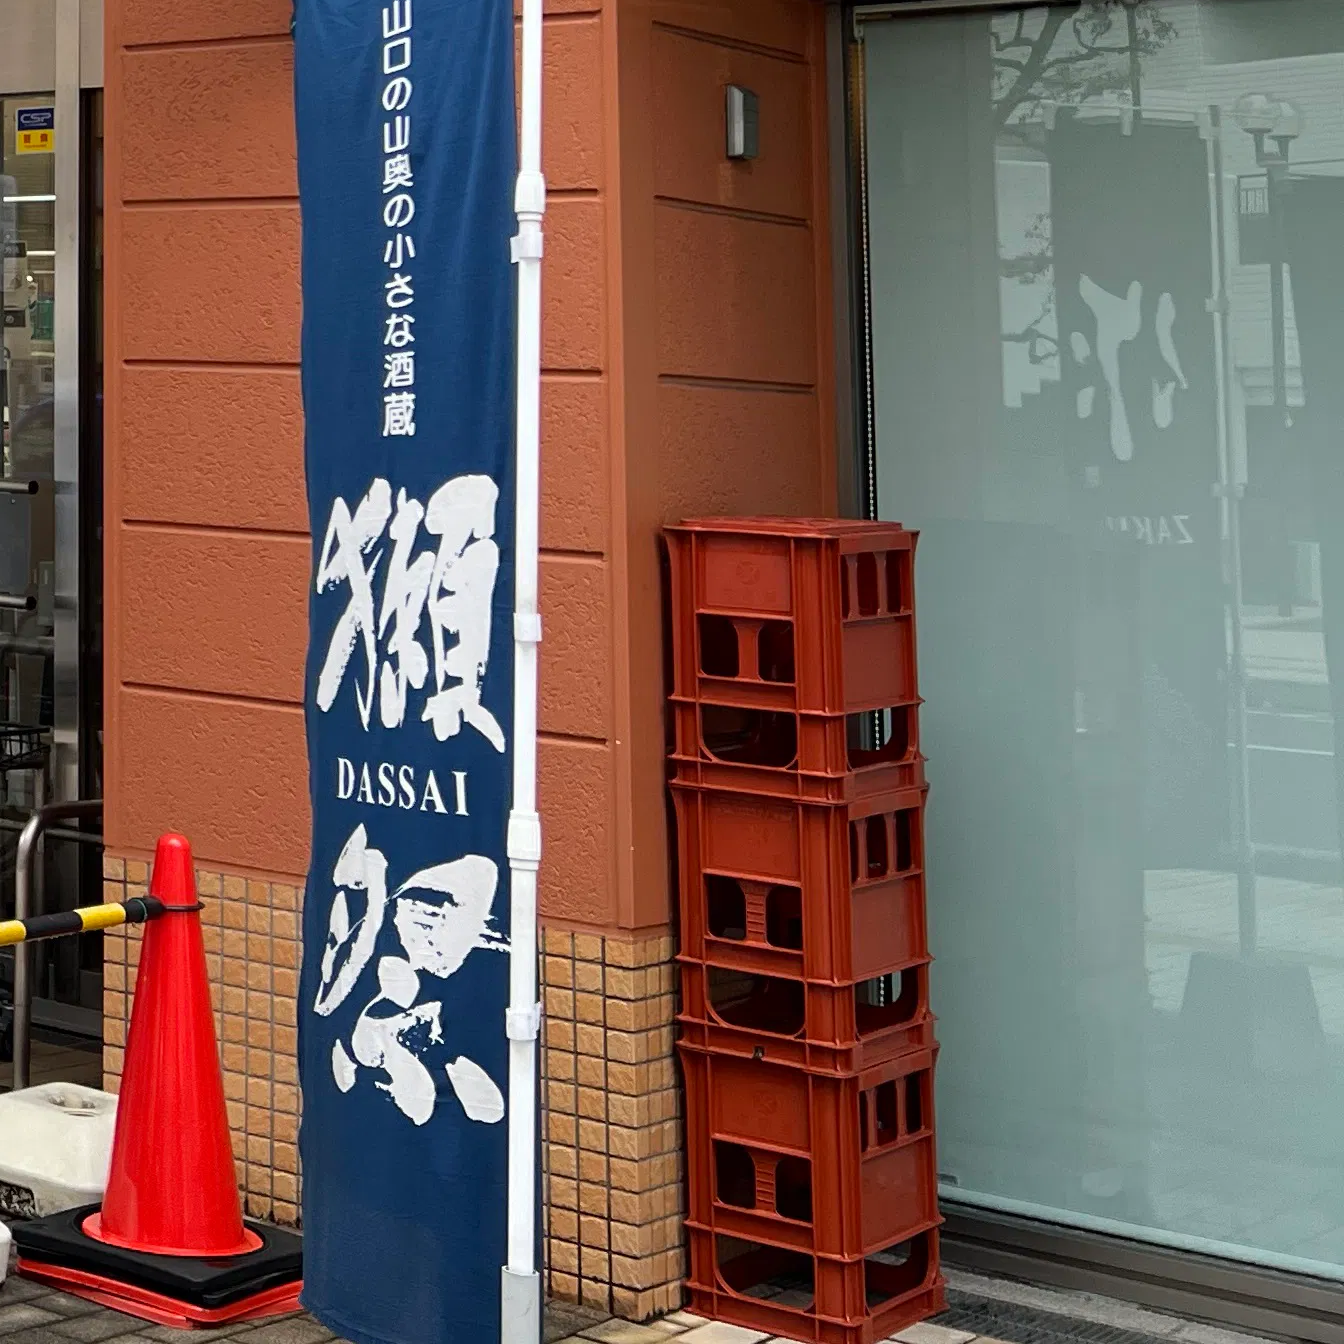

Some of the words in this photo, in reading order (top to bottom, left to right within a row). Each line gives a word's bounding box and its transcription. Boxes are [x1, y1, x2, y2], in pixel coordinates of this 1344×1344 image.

[382, 0, 416, 437] 山口の山奥の小さな酒蔵
[337, 757, 470, 817] DASSAI
